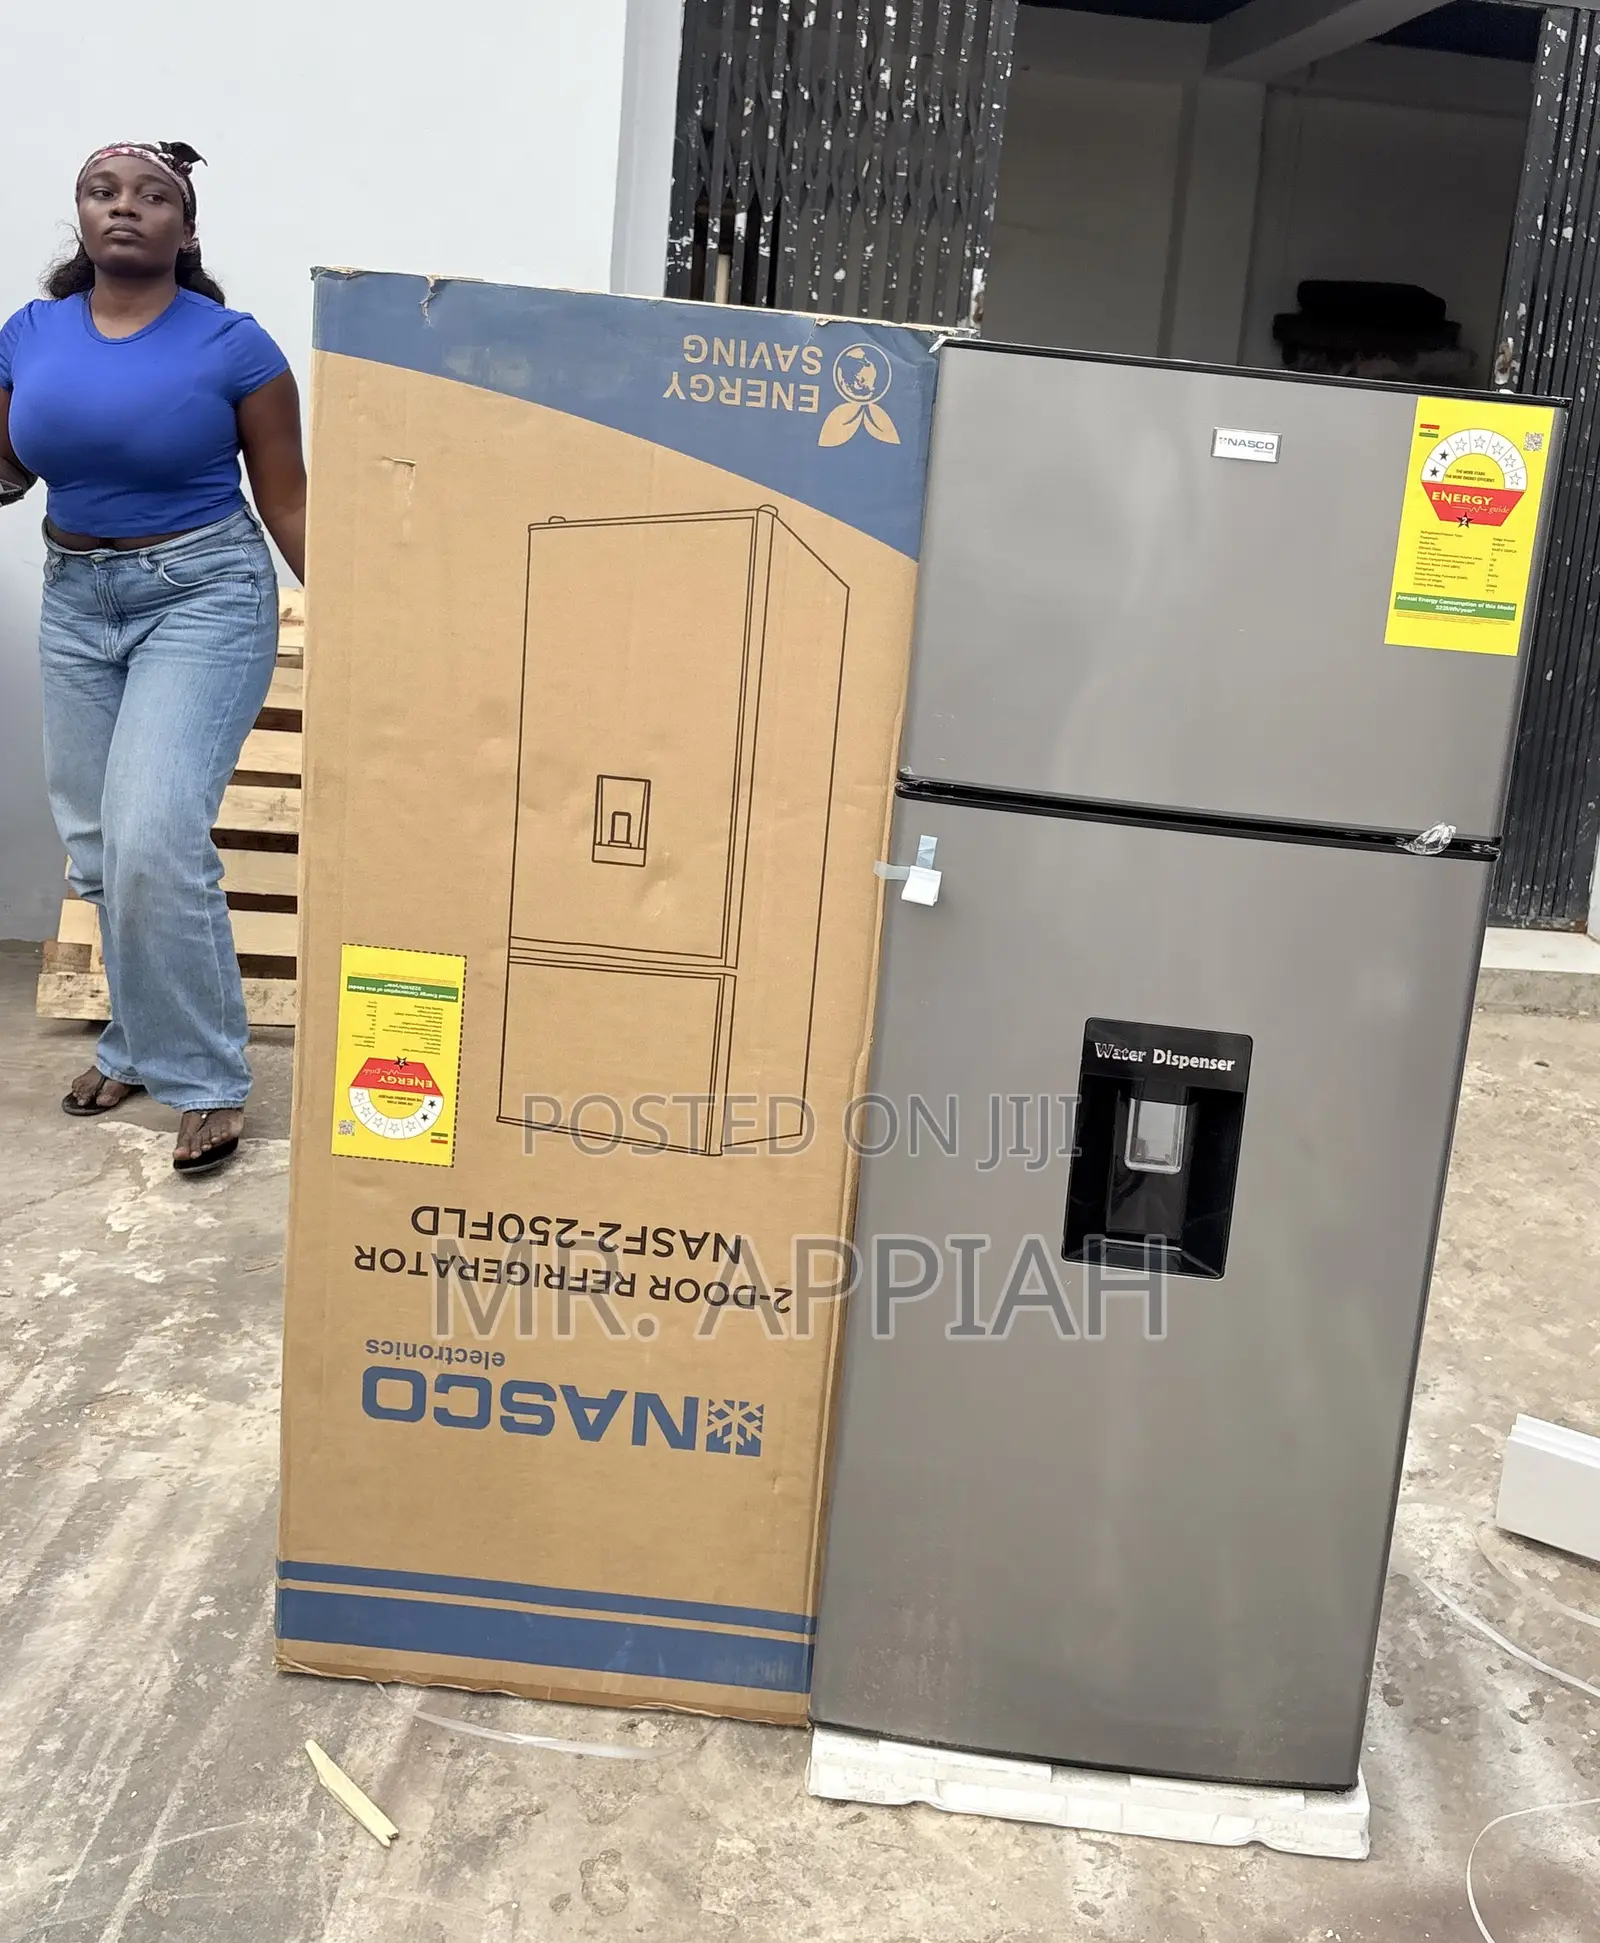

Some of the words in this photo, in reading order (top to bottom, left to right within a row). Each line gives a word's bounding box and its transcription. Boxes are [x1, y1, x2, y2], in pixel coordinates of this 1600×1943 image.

[683, 334, 823, 375] SAVING
[662, 371, 820, 414] ENERGY
[1228, 438, 1275, 450] NASCO
[1431, 490, 1494, 506] ENERGY
[1094, 1042, 1147, 1063] Water
[1152, 1048, 1236, 1072] Dispenser
[377, 1075, 433, 1089] ENERGY
[411, 1205, 742, 1265] NASF2-250FLD
[354, 1244, 636, 1298] REFRIGERATOR
[648, 1274, 793, 1314] 2-DOOR
[365, 1338, 506, 1370] electronics
[362, 1365, 700, 1451] NASCO
